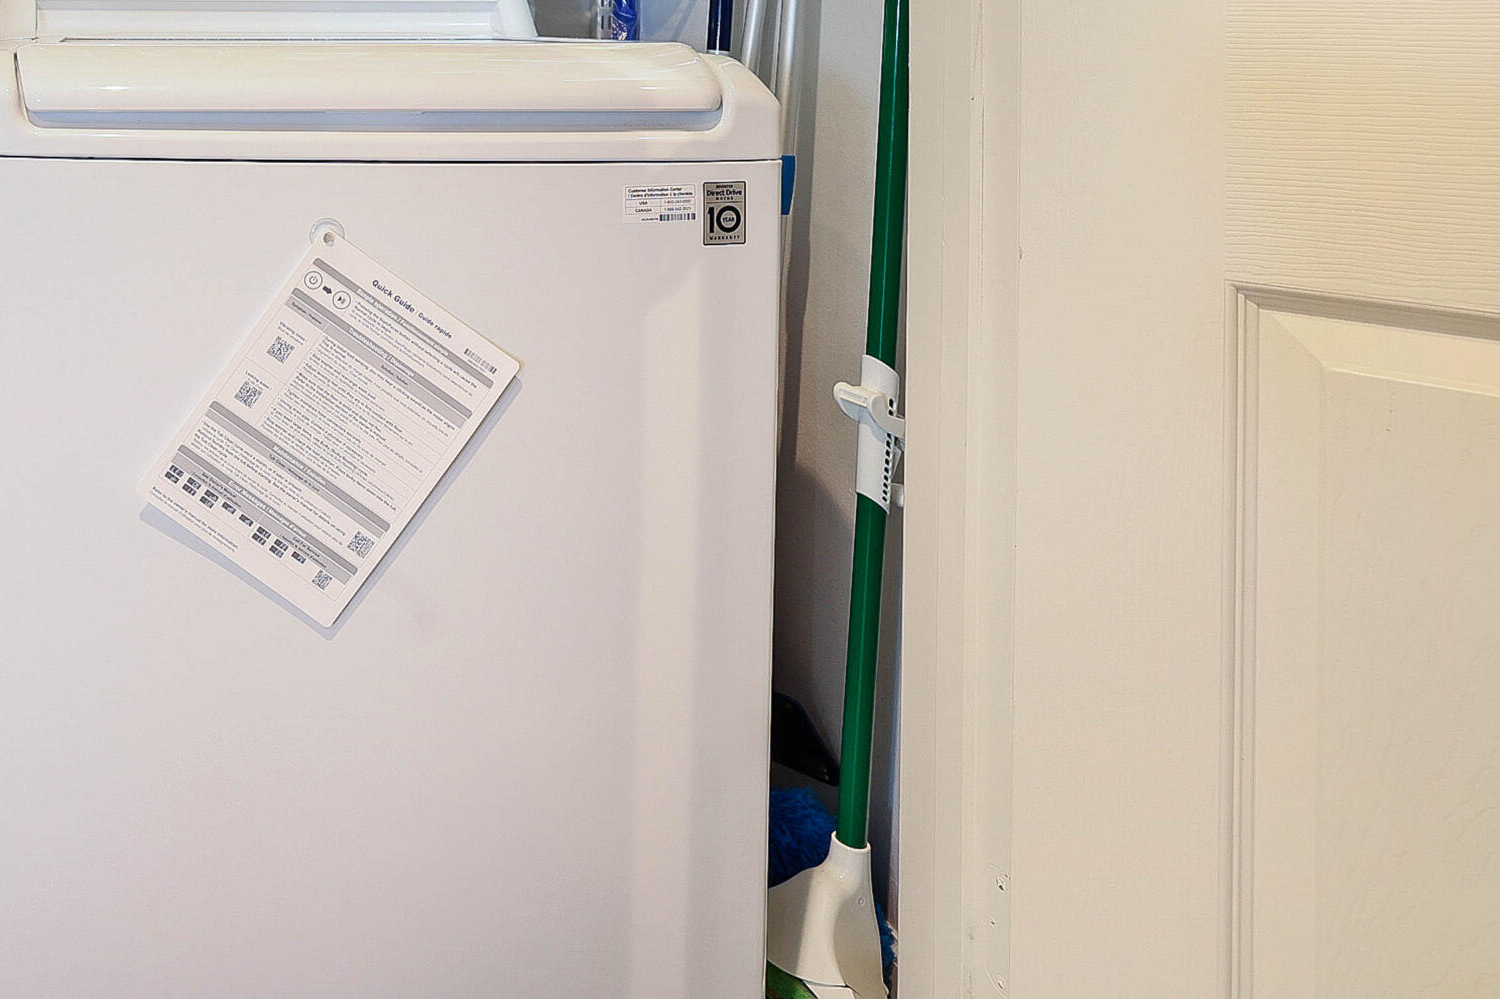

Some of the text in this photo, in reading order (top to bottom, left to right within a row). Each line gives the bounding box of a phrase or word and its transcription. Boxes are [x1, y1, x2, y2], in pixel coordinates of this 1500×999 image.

[707, 205, 742, 233] 10
[371, 279, 394, 297] Quick
[392, 294, 416, 313] Guide
[417, 312, 434, 326] Guide
[433, 323, 452, 339] rapide
[227, 480, 242, 493] Error
[241, 490, 265, 509] Messages
